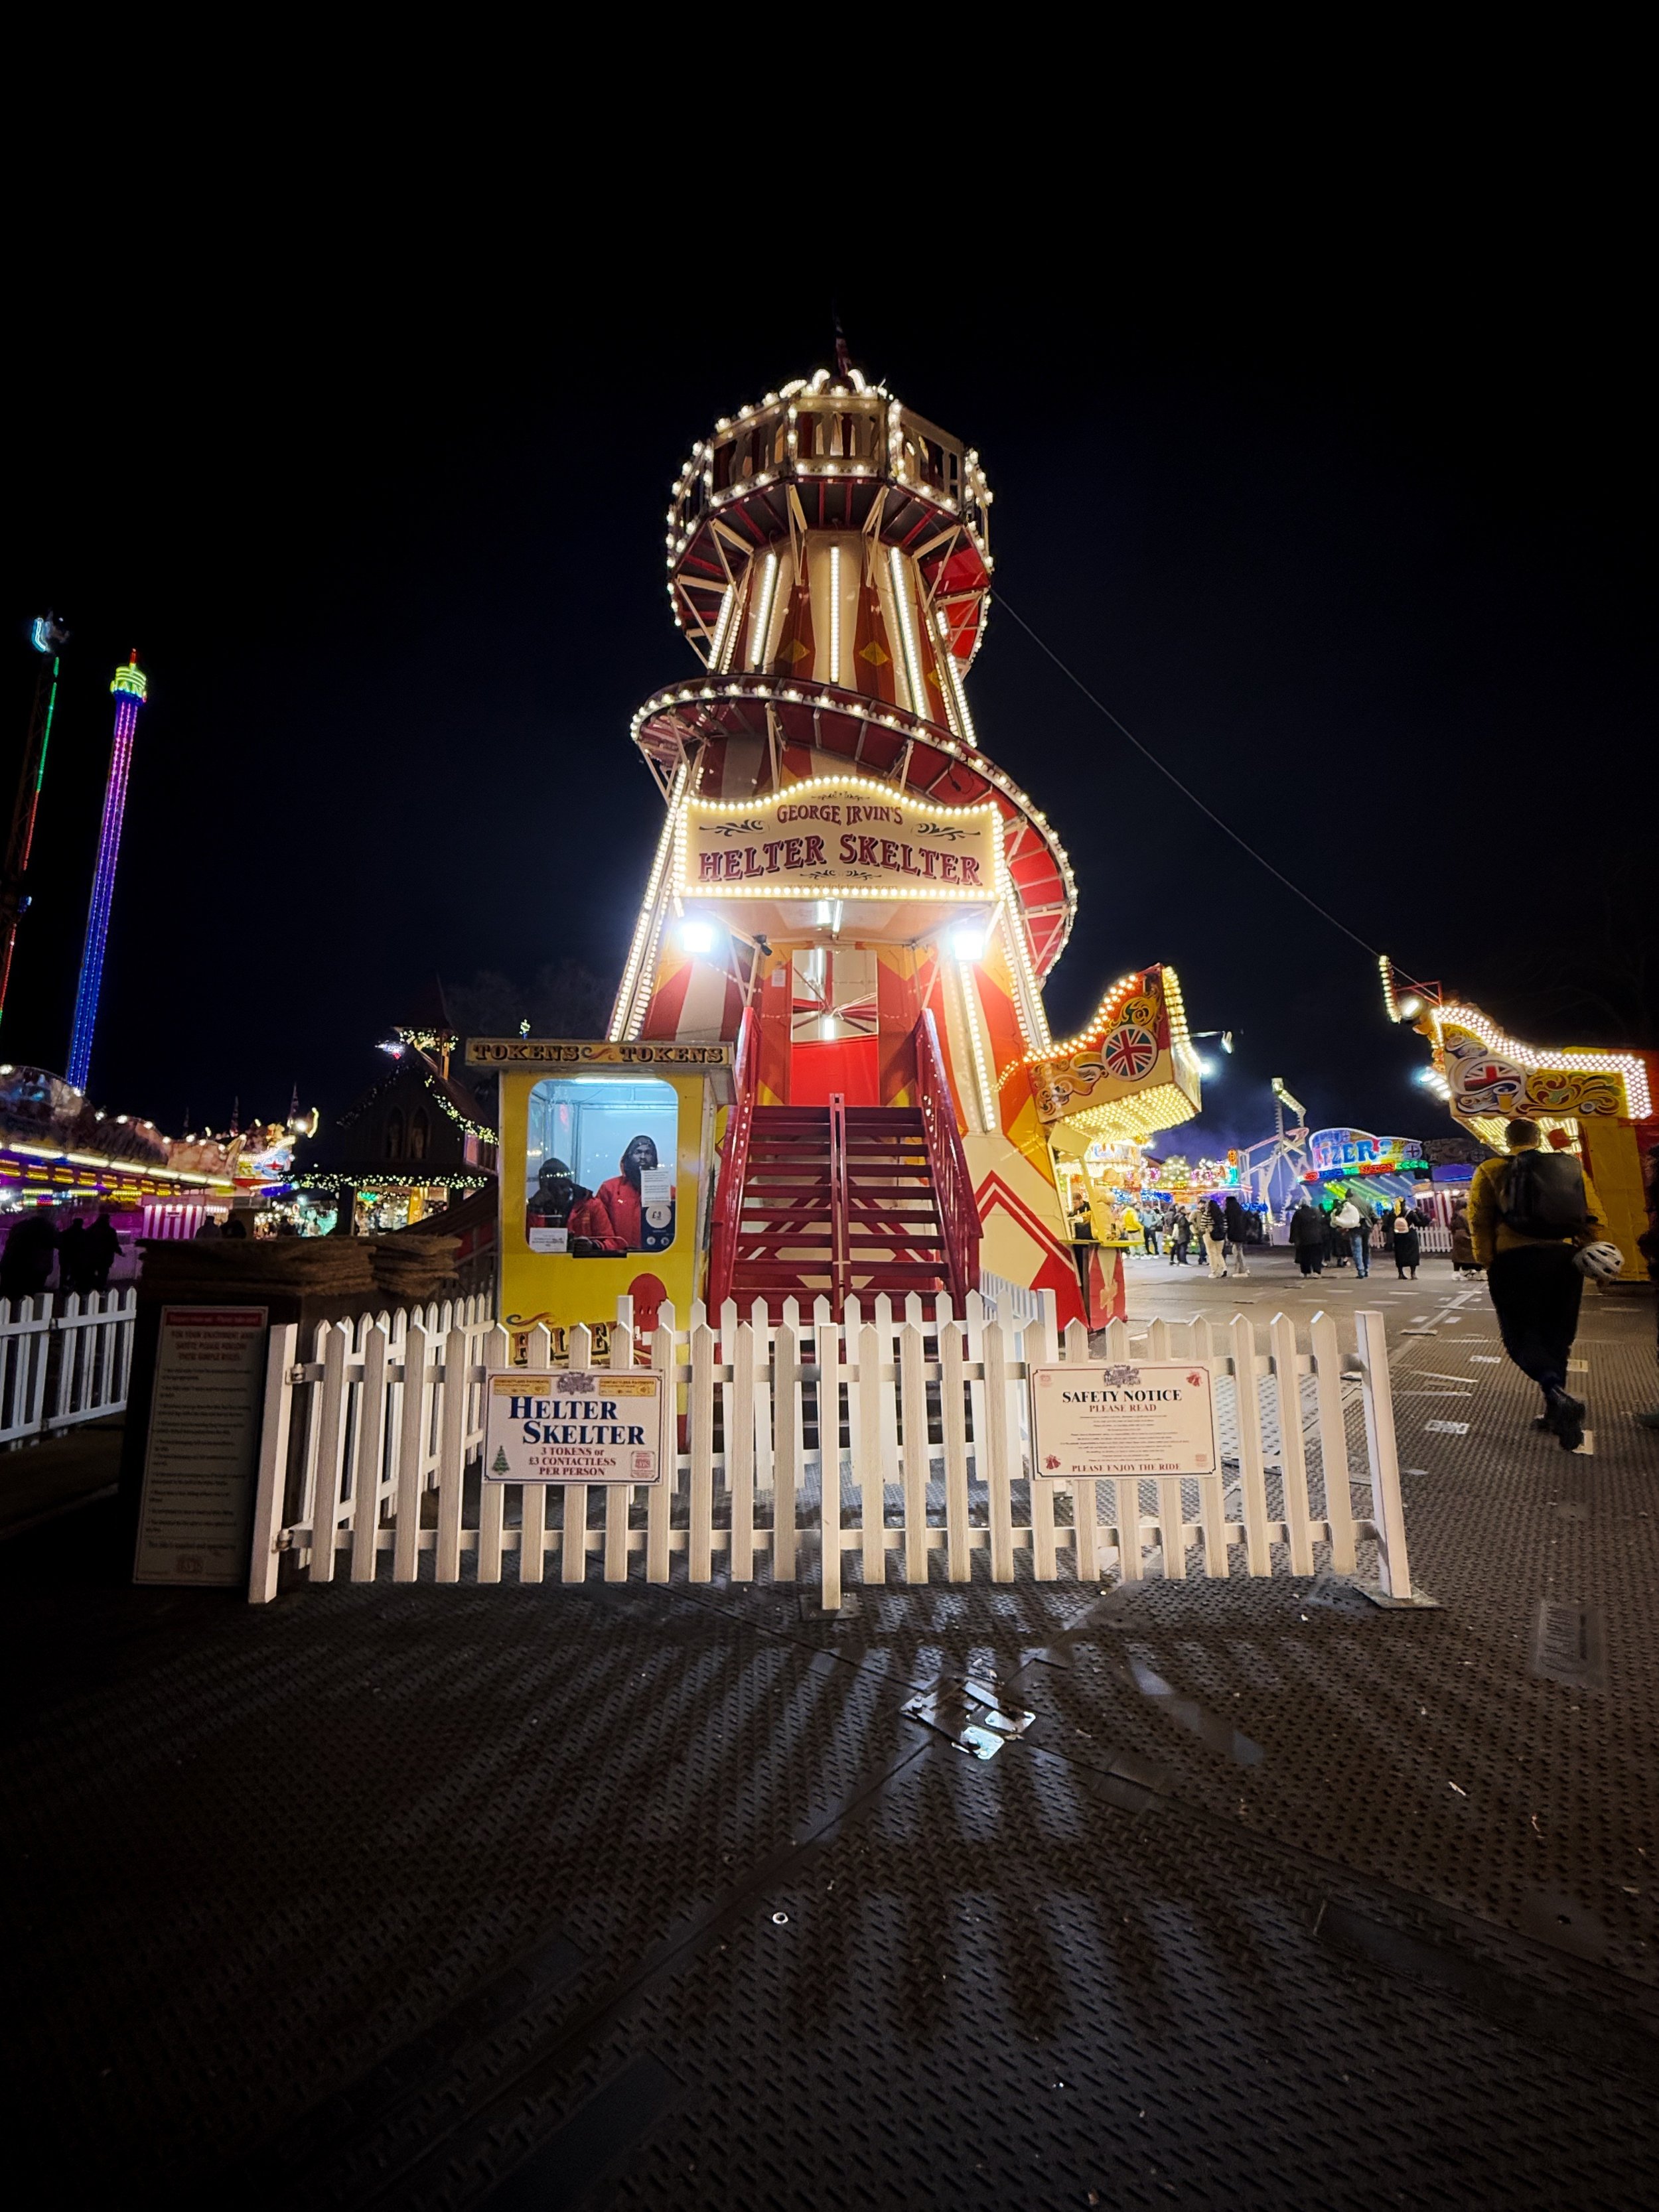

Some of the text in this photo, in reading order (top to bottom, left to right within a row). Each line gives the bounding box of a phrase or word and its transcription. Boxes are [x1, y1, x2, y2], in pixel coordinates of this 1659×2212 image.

[777, 803, 903, 825] GEORGE IRVIN'S
[698, 833, 983, 886] HELTER SKELTER
[474, 1044, 579, 1062] TOKENS
[620, 1046, 724, 1063] TOKENS
[652, 1211, 662, 1219] £3
[1062, 1389, 1183, 1403] SAFETY NOTICE
[508, 1396, 618, 1420] HELTER
[522, 1420, 645, 1444] SKELTER
[541, 1447, 547, 1456] 3
[550, 1447, 592, 1456] TOKENS
[539, 1467, 605, 1476] PER PERSON
